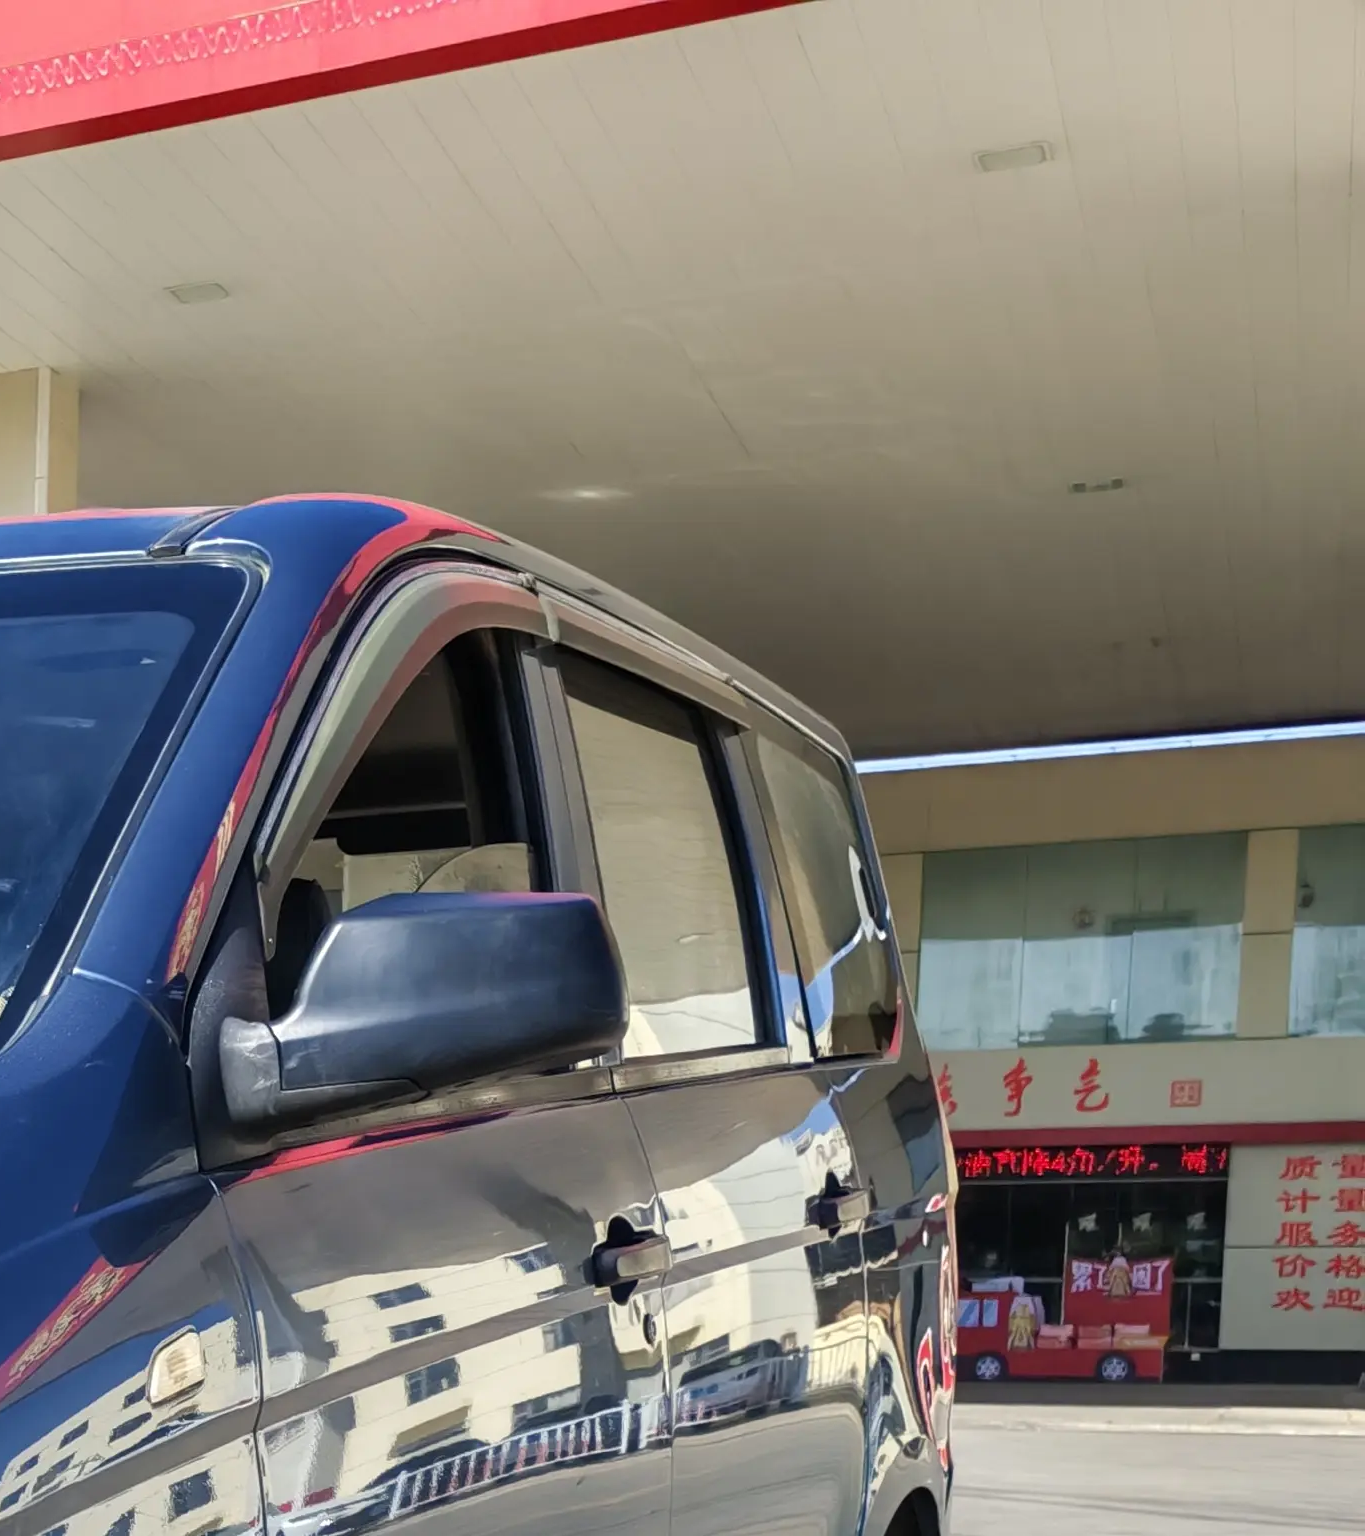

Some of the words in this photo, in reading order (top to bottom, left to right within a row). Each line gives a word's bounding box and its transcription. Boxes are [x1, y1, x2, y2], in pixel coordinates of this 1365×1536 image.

[1279, 1154, 1365, 1181] 质量
[1276, 1188, 1365, 1214] 计量
[1274, 1220, 1365, 1247] 服务
[1272, 1254, 1365, 1279] 价格
[1271, 1286, 1365, 1312] 欢迎
